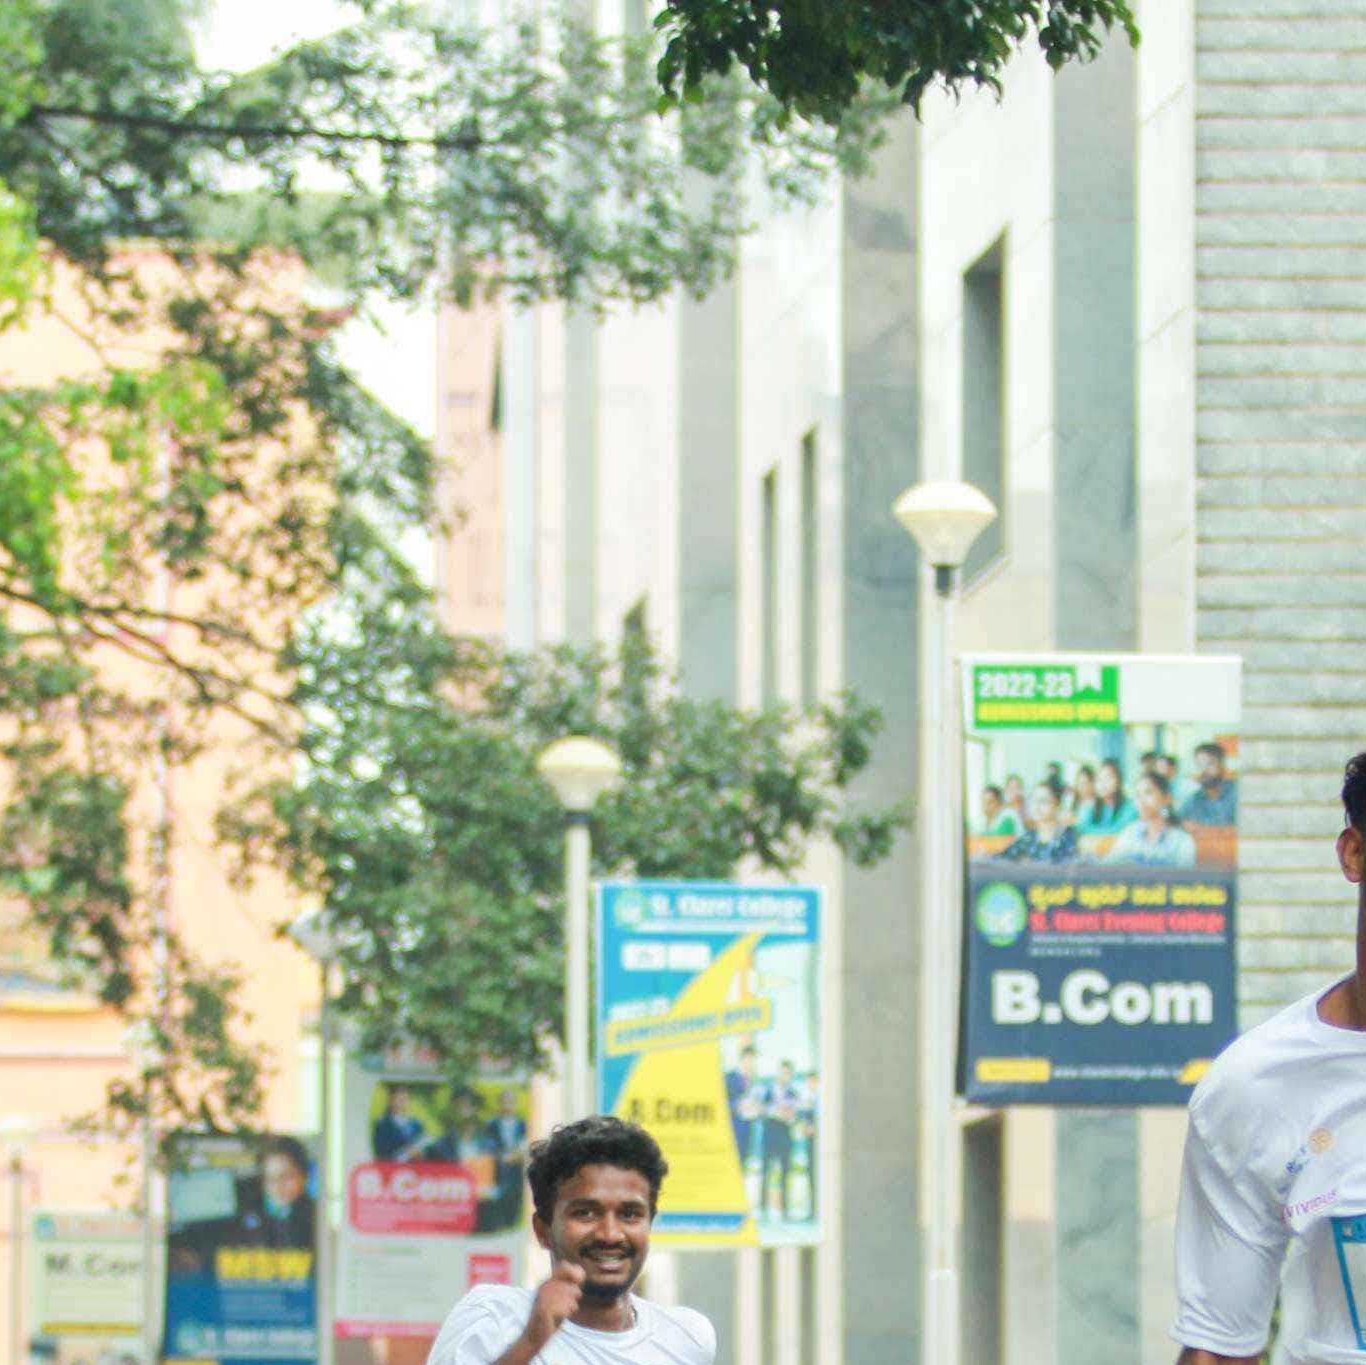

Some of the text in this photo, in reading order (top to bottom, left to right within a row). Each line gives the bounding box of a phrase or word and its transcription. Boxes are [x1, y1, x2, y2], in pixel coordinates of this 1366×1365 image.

[978, 671, 1073, 698] 2022-23
[990, 968, 1214, 1026] B.Com
[355, 1168, 472, 1200] B.Com
